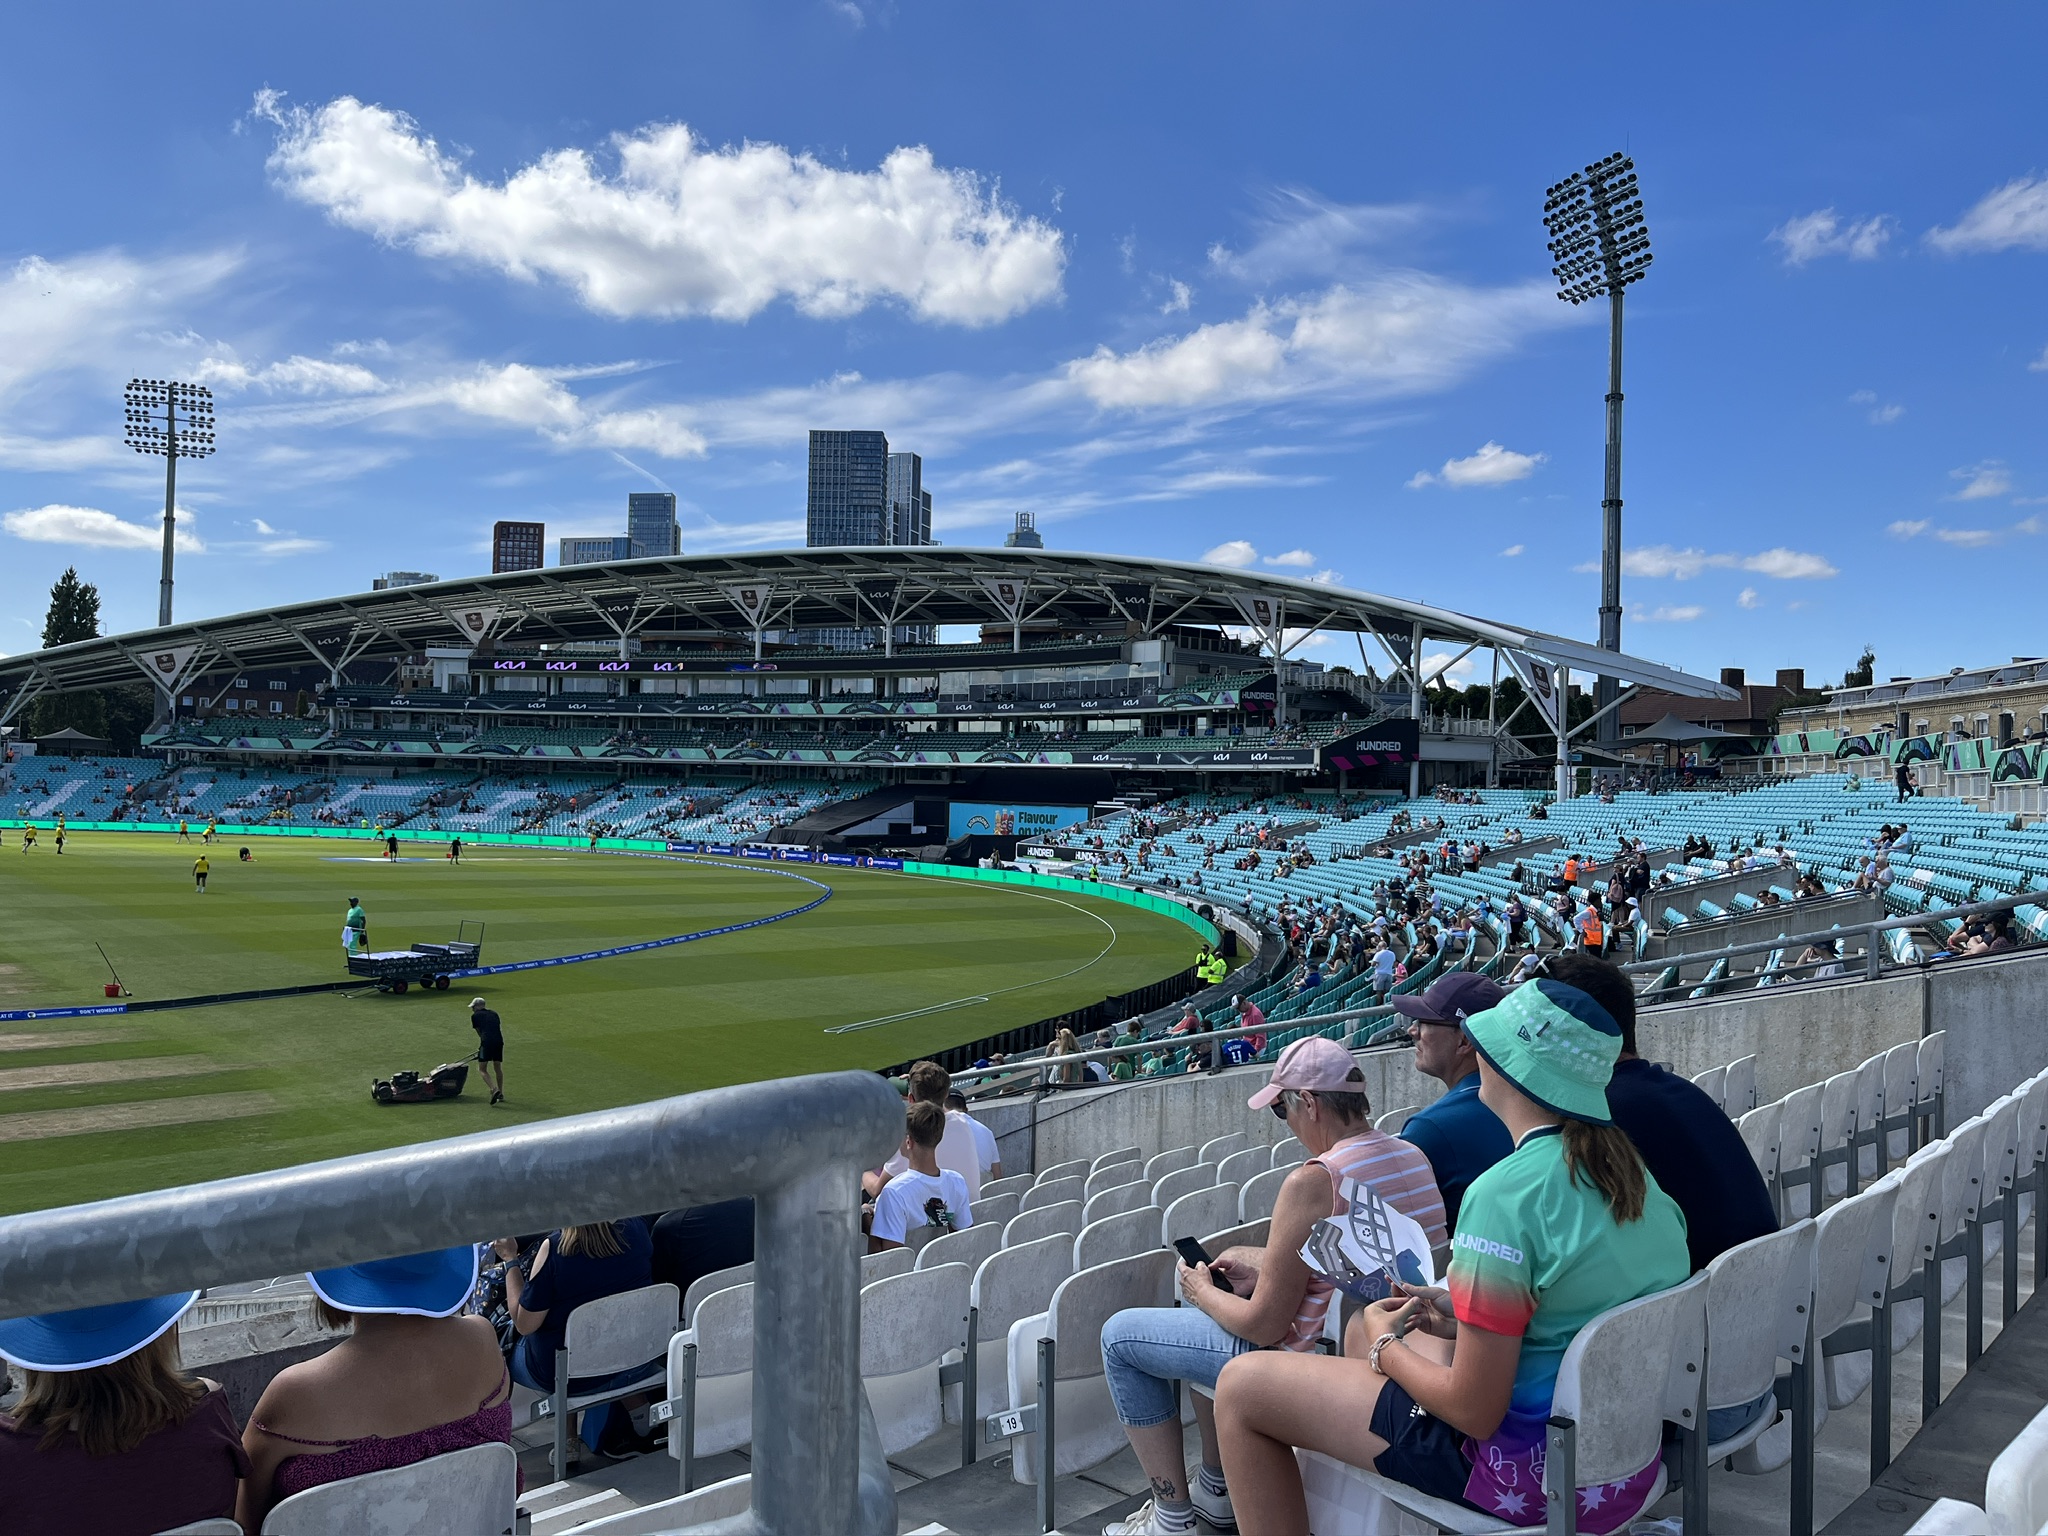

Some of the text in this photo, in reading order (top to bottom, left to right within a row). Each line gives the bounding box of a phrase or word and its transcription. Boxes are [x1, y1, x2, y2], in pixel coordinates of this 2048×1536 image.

[1242, 692, 1275, 700] HUNDRED
[1357, 741, 1401, 751] HUNDRED
[1018, 811, 1058, 825] Flavour
[1027, 846, 1054, 858] HUNDRED
[1455, 1232, 1523, 1265] HUNDRED
[1006, 1417, 1017, 1430] 19
